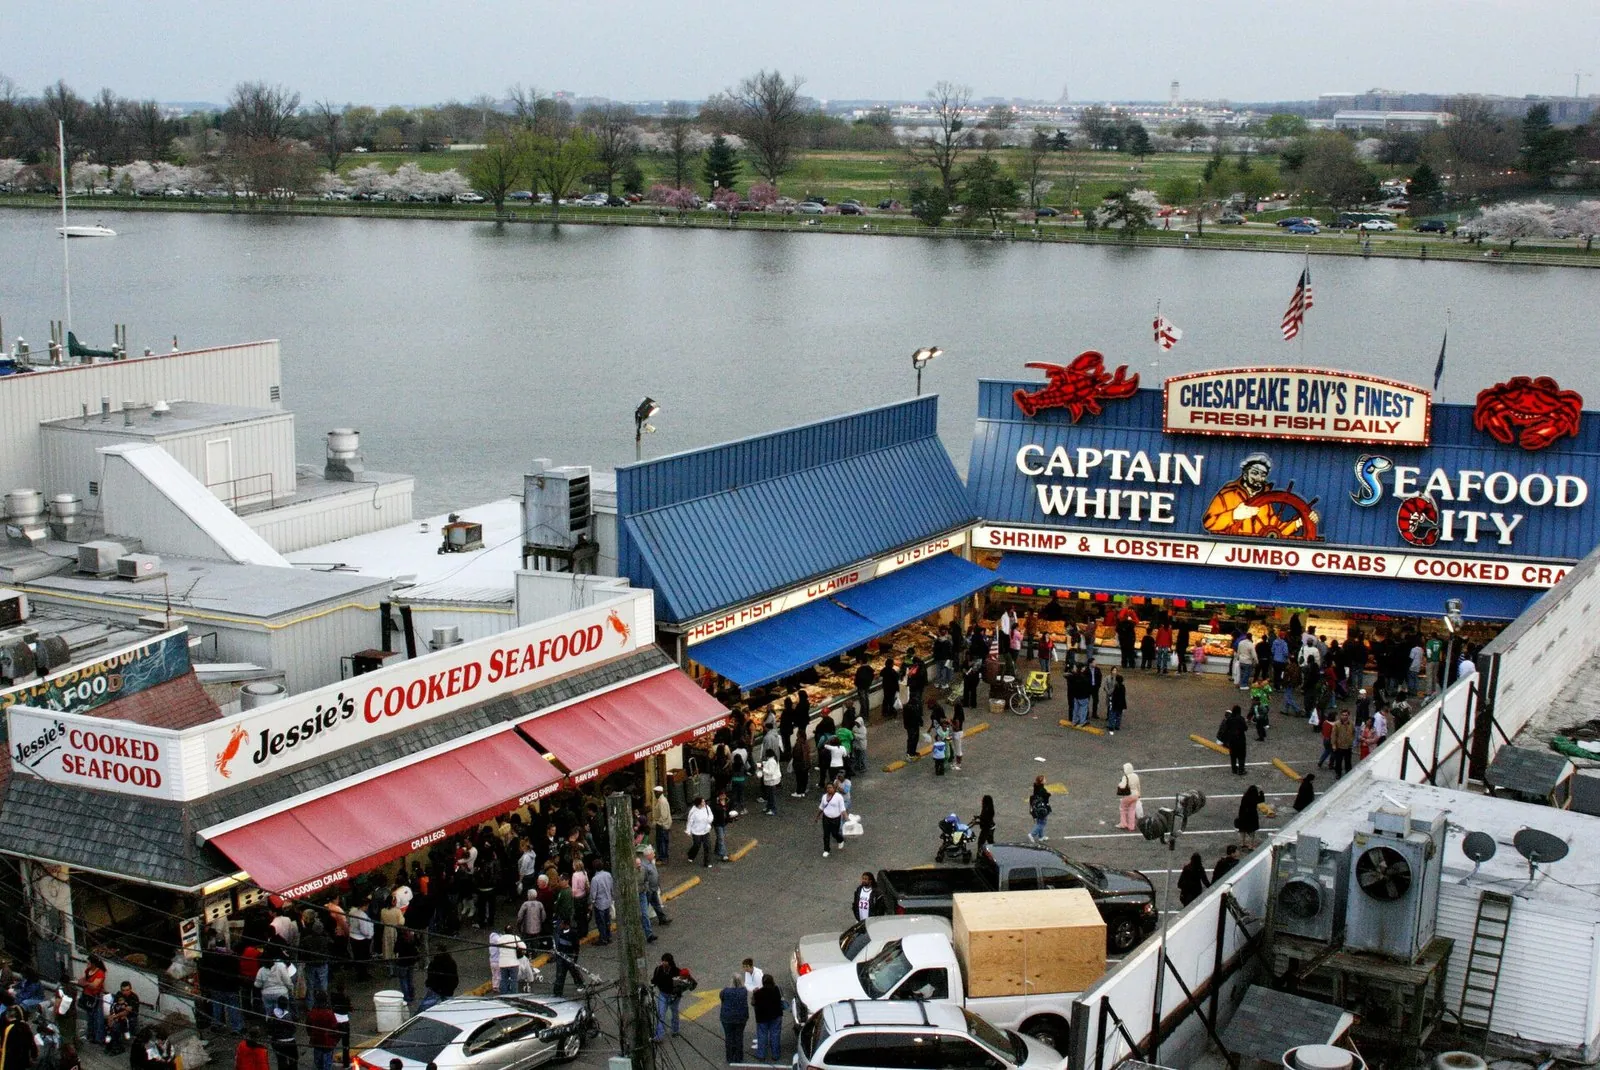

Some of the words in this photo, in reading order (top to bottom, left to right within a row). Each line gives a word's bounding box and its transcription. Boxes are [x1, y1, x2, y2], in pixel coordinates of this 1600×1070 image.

[1180, 378, 1289, 413] CHESAPEAKE
[1297, 379, 1347, 415] BAY'S
[1355, 386, 1413, 418] FINEST
[1190, 411, 1266, 427] FRESH
[1273, 415, 1328, 431] FISH
[1333, 417, 1401, 435] DAILY
[1016, 444, 1203, 486] CAPTAIN
[1036, 484, 1175, 524] WHITE
[989, 530, 1066, 549] SHRIMP
[1078, 536, 1090, 552] &
[1104, 537, 1199, 560] LOBSTER
[1224, 549, 1300, 567] JUMBO
[1312, 553, 1386, 574] CRABS
[1414, 559, 1509, 581] COOKED
[253, 693, 354, 765] Jessie's
[363, 661, 481, 724] COOKED
[487, 624, 603, 683] SEAFOOD
[693, 726, 706, 737] FRIED
[706, 718, 726, 733] DINNERS
[16, 720, 66, 762] Jessie's
[69, 729, 159, 762] COOKED
[634, 747, 650, 760] MAINE
[650, 739, 673, 755] LOBSTER
[62, 754, 161, 788] SEAFOOD
[575, 773, 587, 784] RAW
[588, 769, 599, 781] BAR
[519, 791, 538, 806] SPICED
[539, 783, 559, 799] SHRIMP
[411, 836, 429, 849] CRAB
[429, 829, 446, 842] LEGS
[294, 880, 322, 896] COOKED
[323, 869, 348, 885] CRABS
[859, 901, 869, 910] 32
